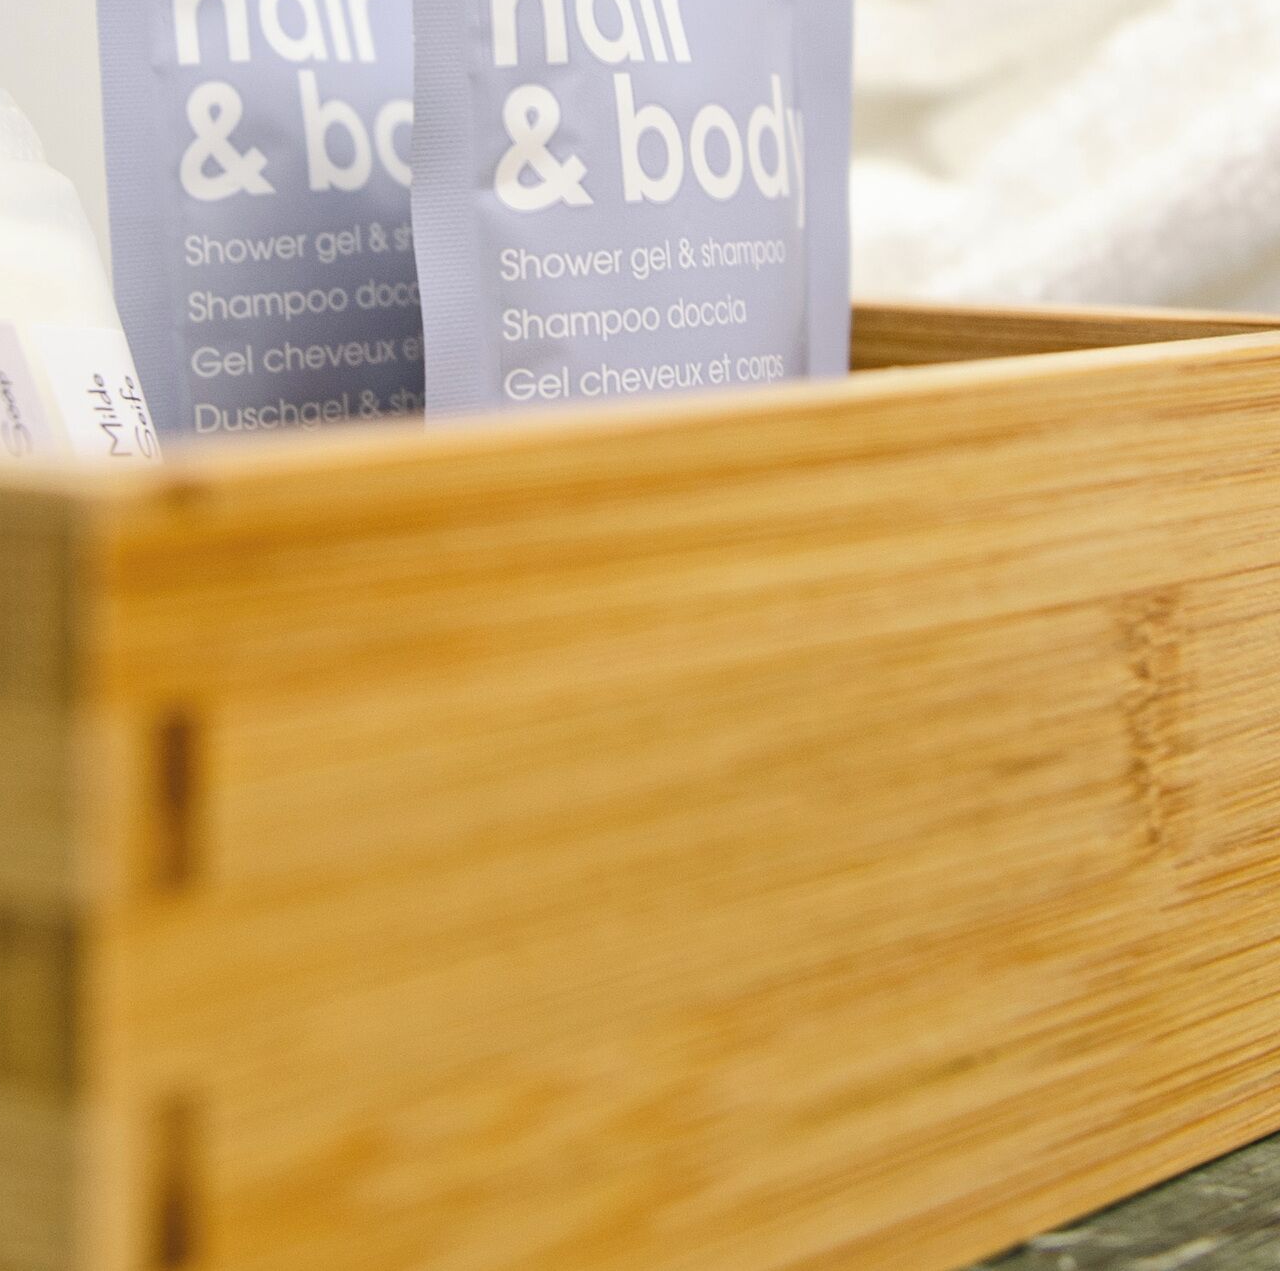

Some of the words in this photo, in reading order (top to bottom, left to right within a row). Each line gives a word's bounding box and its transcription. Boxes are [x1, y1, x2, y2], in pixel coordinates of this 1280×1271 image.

[179, 80, 277, 202] &
[297, 68, 414, 192] bo
[494, 83, 595, 212] &
[613, 72, 805, 230] body
[183, 234, 306, 267] Shower
[315, 224, 362, 263] gel
[370, 222, 389, 253] &
[499, 247, 623, 282] Shower
[630, 239, 672, 280] gel
[677, 237, 697, 270] &
[701, 236, 786, 271] shampoo
[187, 289, 349, 323] Shampoo
[501, 308, 661, 342] Shampoo
[666, 294, 747, 330] doccia
[190, 345, 254, 378] Gel
[262, 341, 398, 374] cheveux
[504, 365, 570, 401] Gel
[579, 362, 703, 397] cheveux
[708, 353, 732, 384] et
[736, 352, 785, 383] corps
[87, 372, 133, 457] Milde
[194, 393, 350, 434] Duschgel
